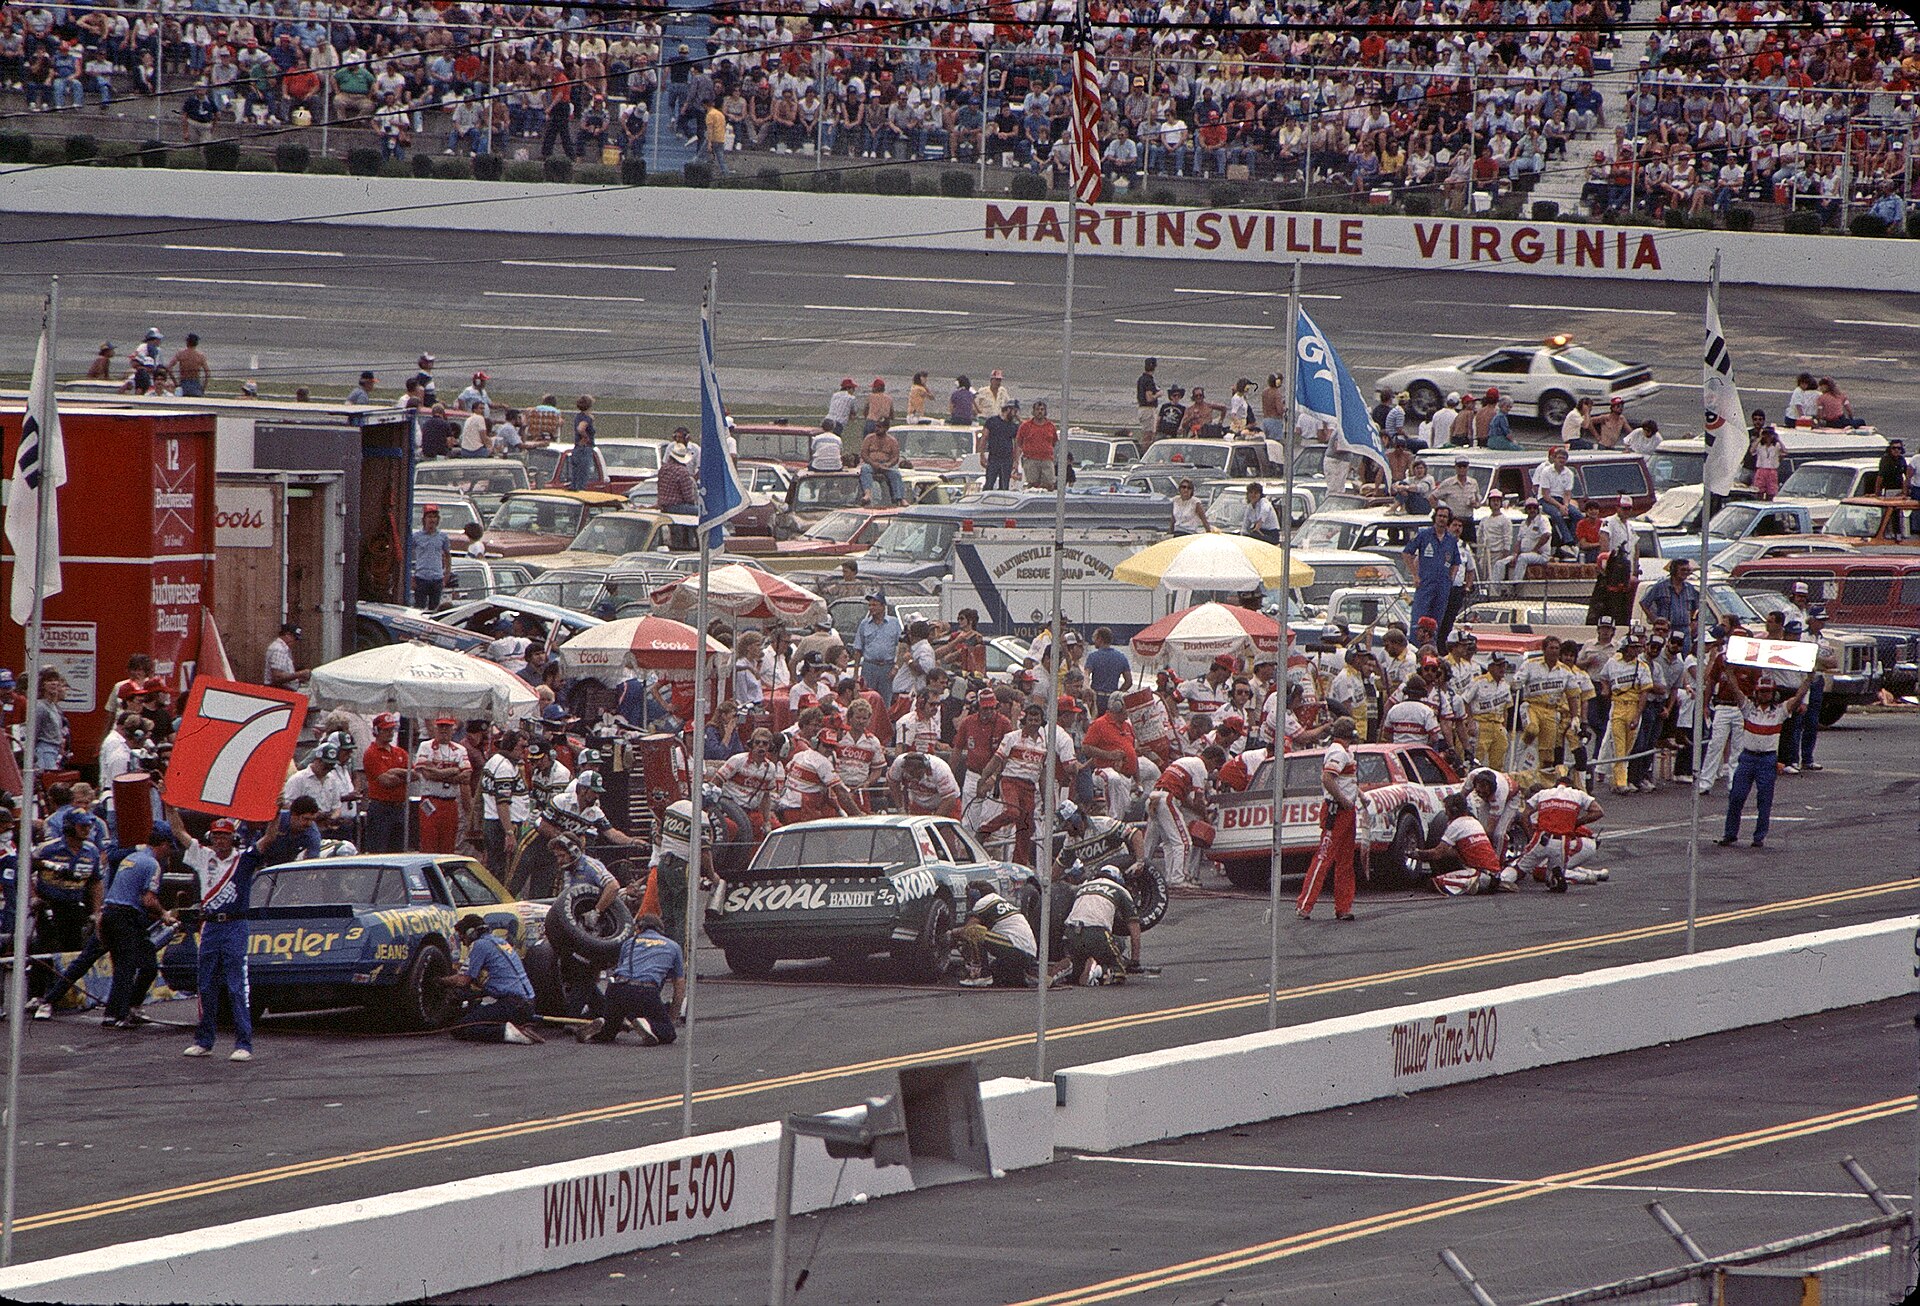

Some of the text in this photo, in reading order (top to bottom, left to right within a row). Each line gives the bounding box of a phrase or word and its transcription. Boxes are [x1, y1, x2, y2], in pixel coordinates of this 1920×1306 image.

[985, 204, 1662, 271] MARTINSVILLE VIRGINIA
[215, 507, 264, 528] oors
[993, 546, 1114, 580] MARTINSVILLE ENRY COUNTY
[1016, 567, 1051, 580] RESCUE
[1061, 570, 1084, 580] QUAD
[157, 608, 189, 638] Racing
[651, 640, 690, 650] Coors
[1183, 641, 1233, 650] Budweiser
[578, 649, 609, 665] Coors
[410, 669, 464, 679] BUSCH
[198, 686, 295, 807] 7
[664, 816, 692, 836] KOAL
[724, 883, 895, 912] SKOAL BANDIT 33
[893, 871, 939, 904] SKOAL
[345, 927, 365, 941] 3
[374, 943, 409, 960] JEANS
[1391, 1006, 1497, 1078] Miller Time 500
[686, 1149, 735, 1219] 500
